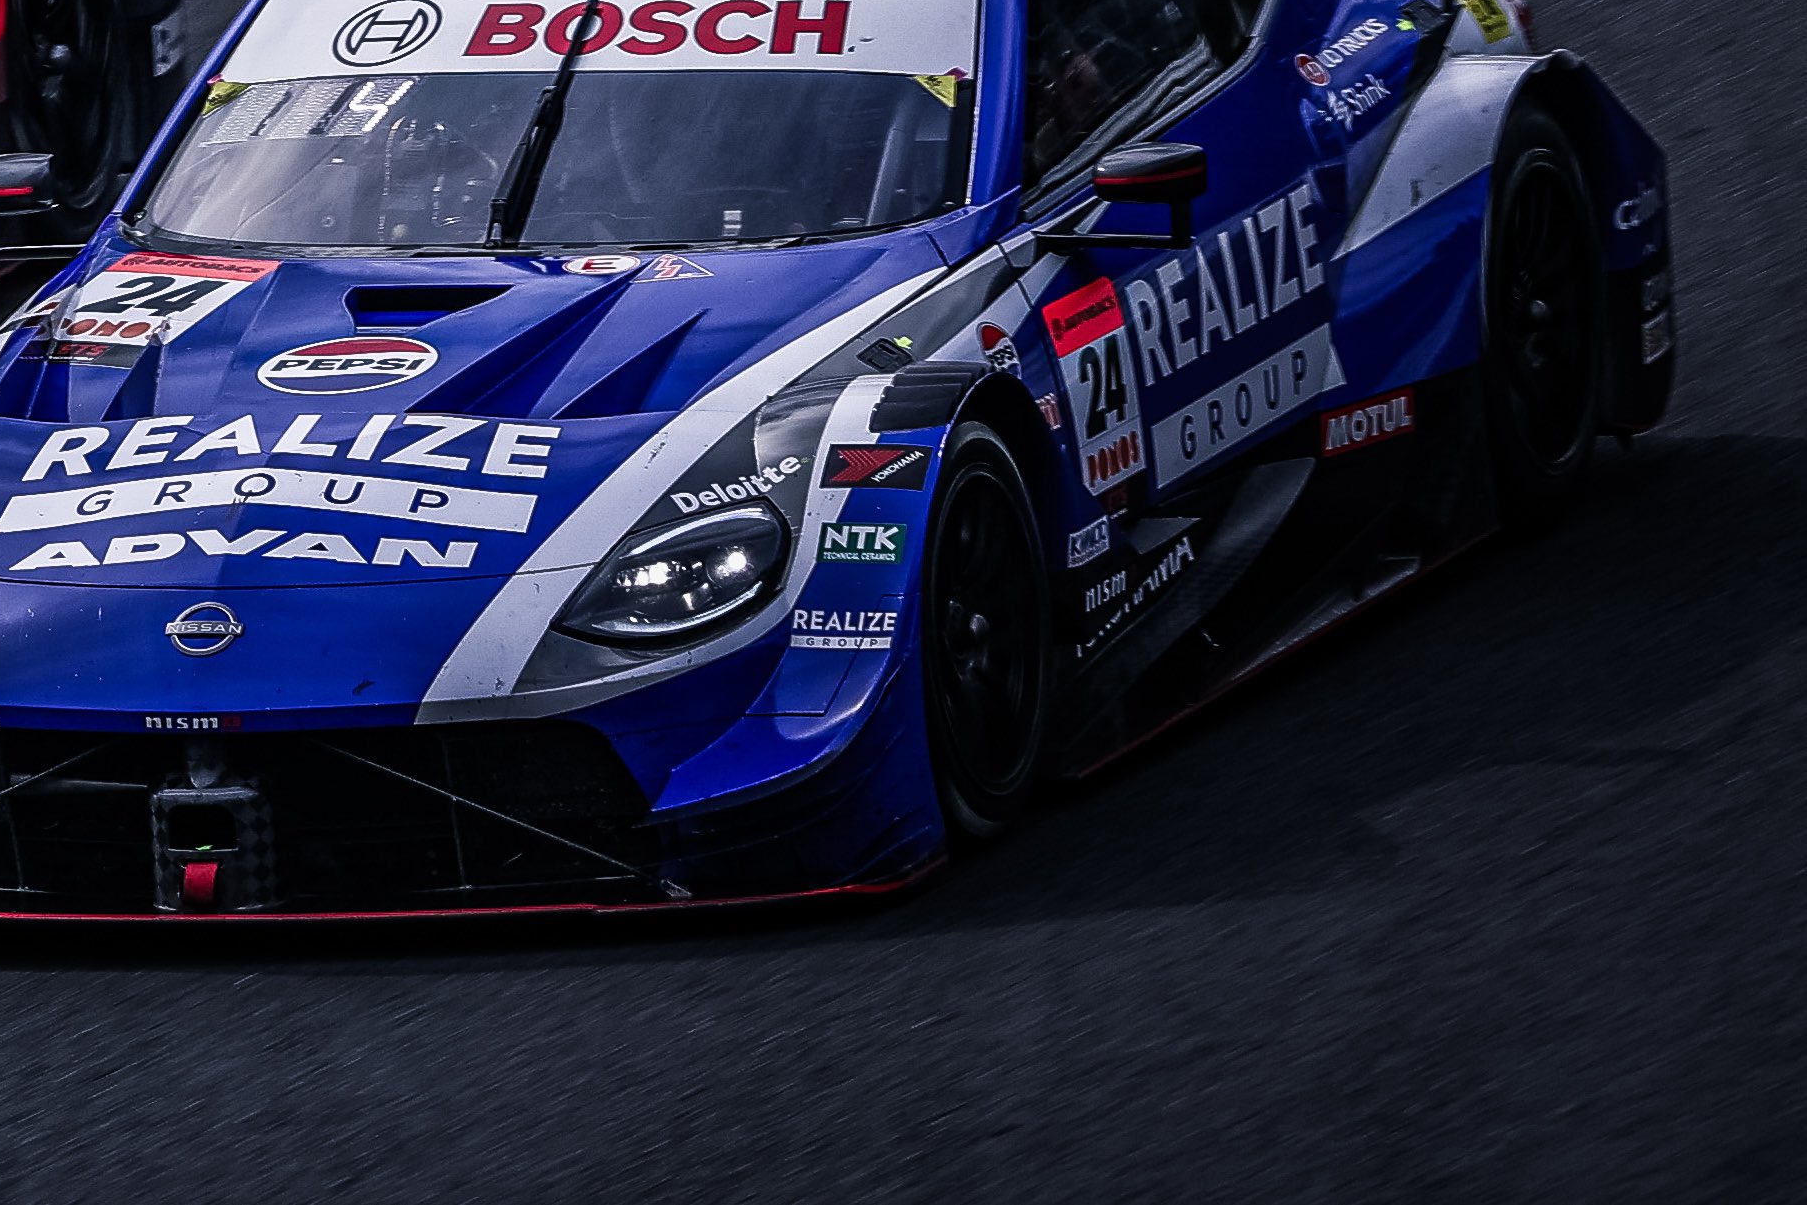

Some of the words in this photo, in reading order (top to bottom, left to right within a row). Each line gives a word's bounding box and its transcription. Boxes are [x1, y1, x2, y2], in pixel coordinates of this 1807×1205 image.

[462, 0, 851, 56] BOSCH
[75, 275, 230, 317] 24
[1124, 183, 1326, 388] REALIZE
[271, 357, 426, 375] PEPSI
[1079, 333, 1127, 440] 24
[1180, 350, 1308, 461] GROUP
[1325, 396, 1413, 451] MOTUL
[22, 413, 561, 482] REALIZE
[870, 450, 925, 483] YOKOHAMA
[77, 472, 449, 516] GROUP
[670, 456, 802, 514] Deloitte
[8, 529, 479, 571] ADVAN
[824, 526, 899, 551] NTK
[166, 623, 242, 634] NISSAN
[792, 609, 897, 631] REALIZE
[806, 637, 879, 648] GROUP
